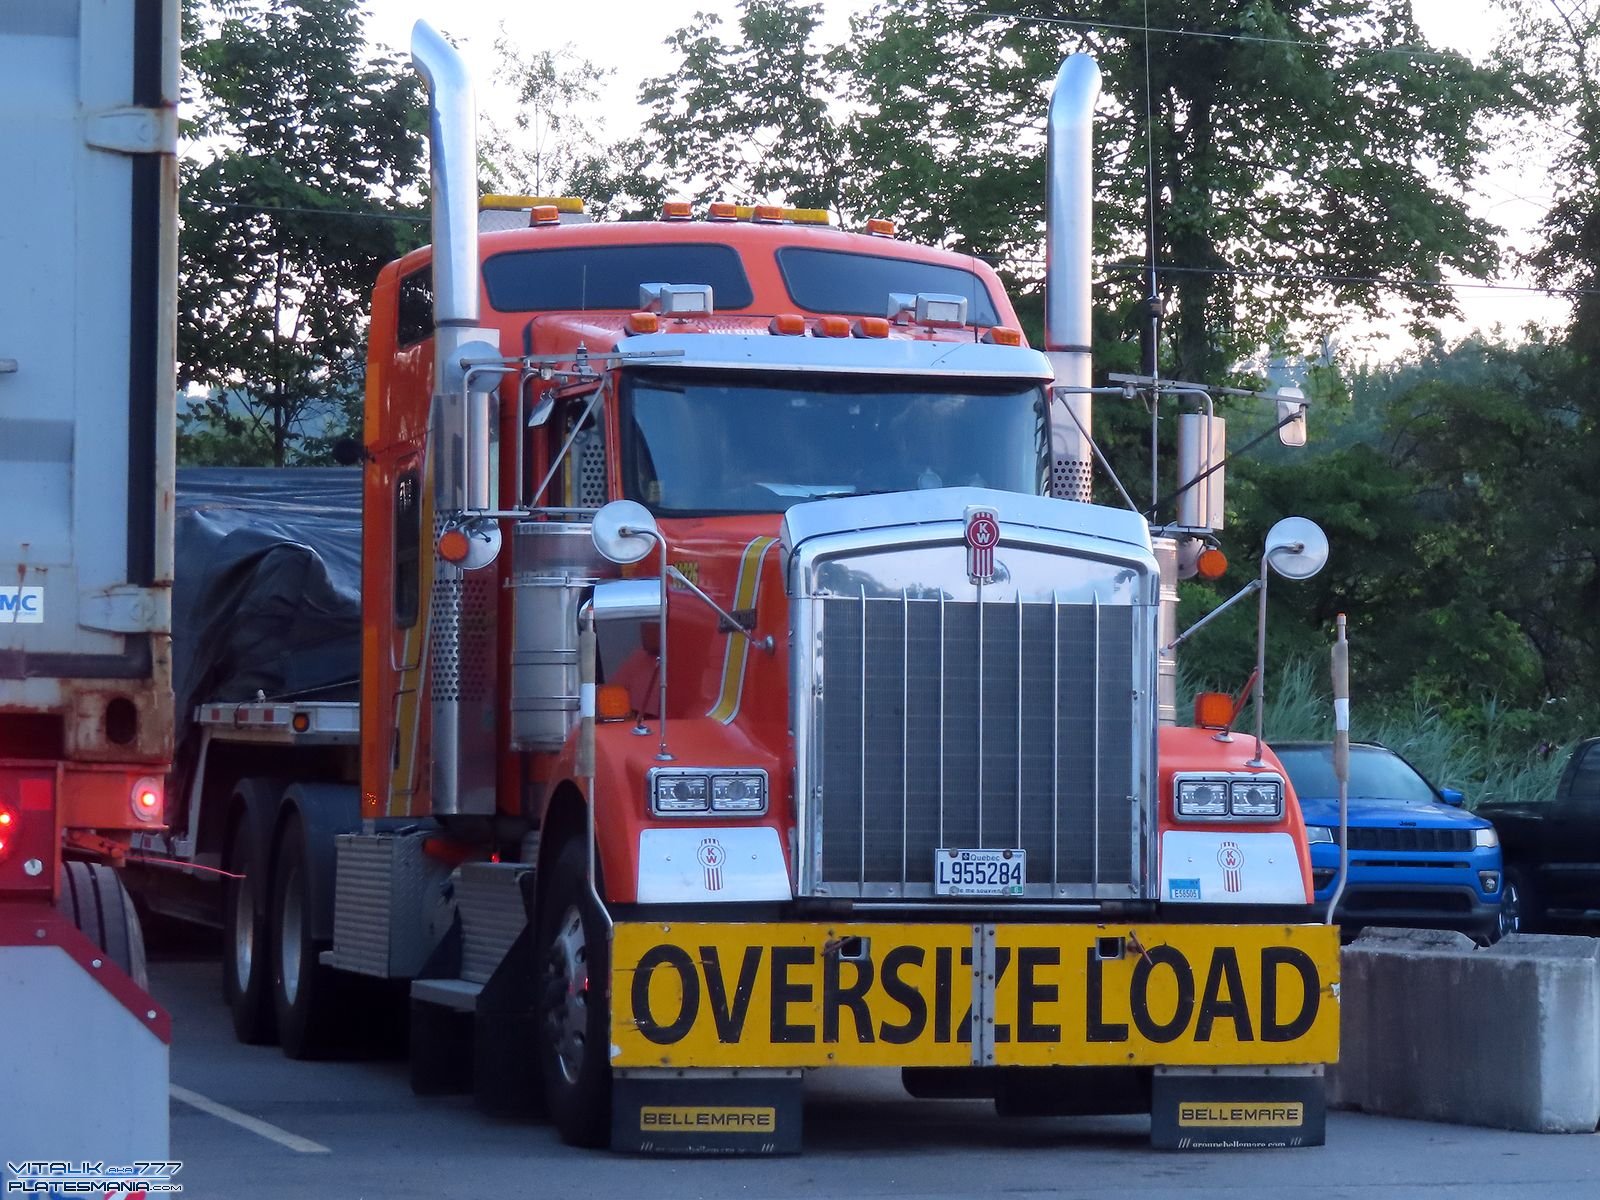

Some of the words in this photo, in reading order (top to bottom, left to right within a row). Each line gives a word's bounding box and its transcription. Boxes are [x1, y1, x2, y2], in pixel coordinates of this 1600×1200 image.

[939, 861, 1022, 885] L955284
[630, 942, 1062, 1046] OVERSIZE
[1085, 944, 1321, 1045] LOAD
[643, 1112, 771, 1126] BELLEMARE
[1181, 1108, 1299, 1121] BELLEMARE
